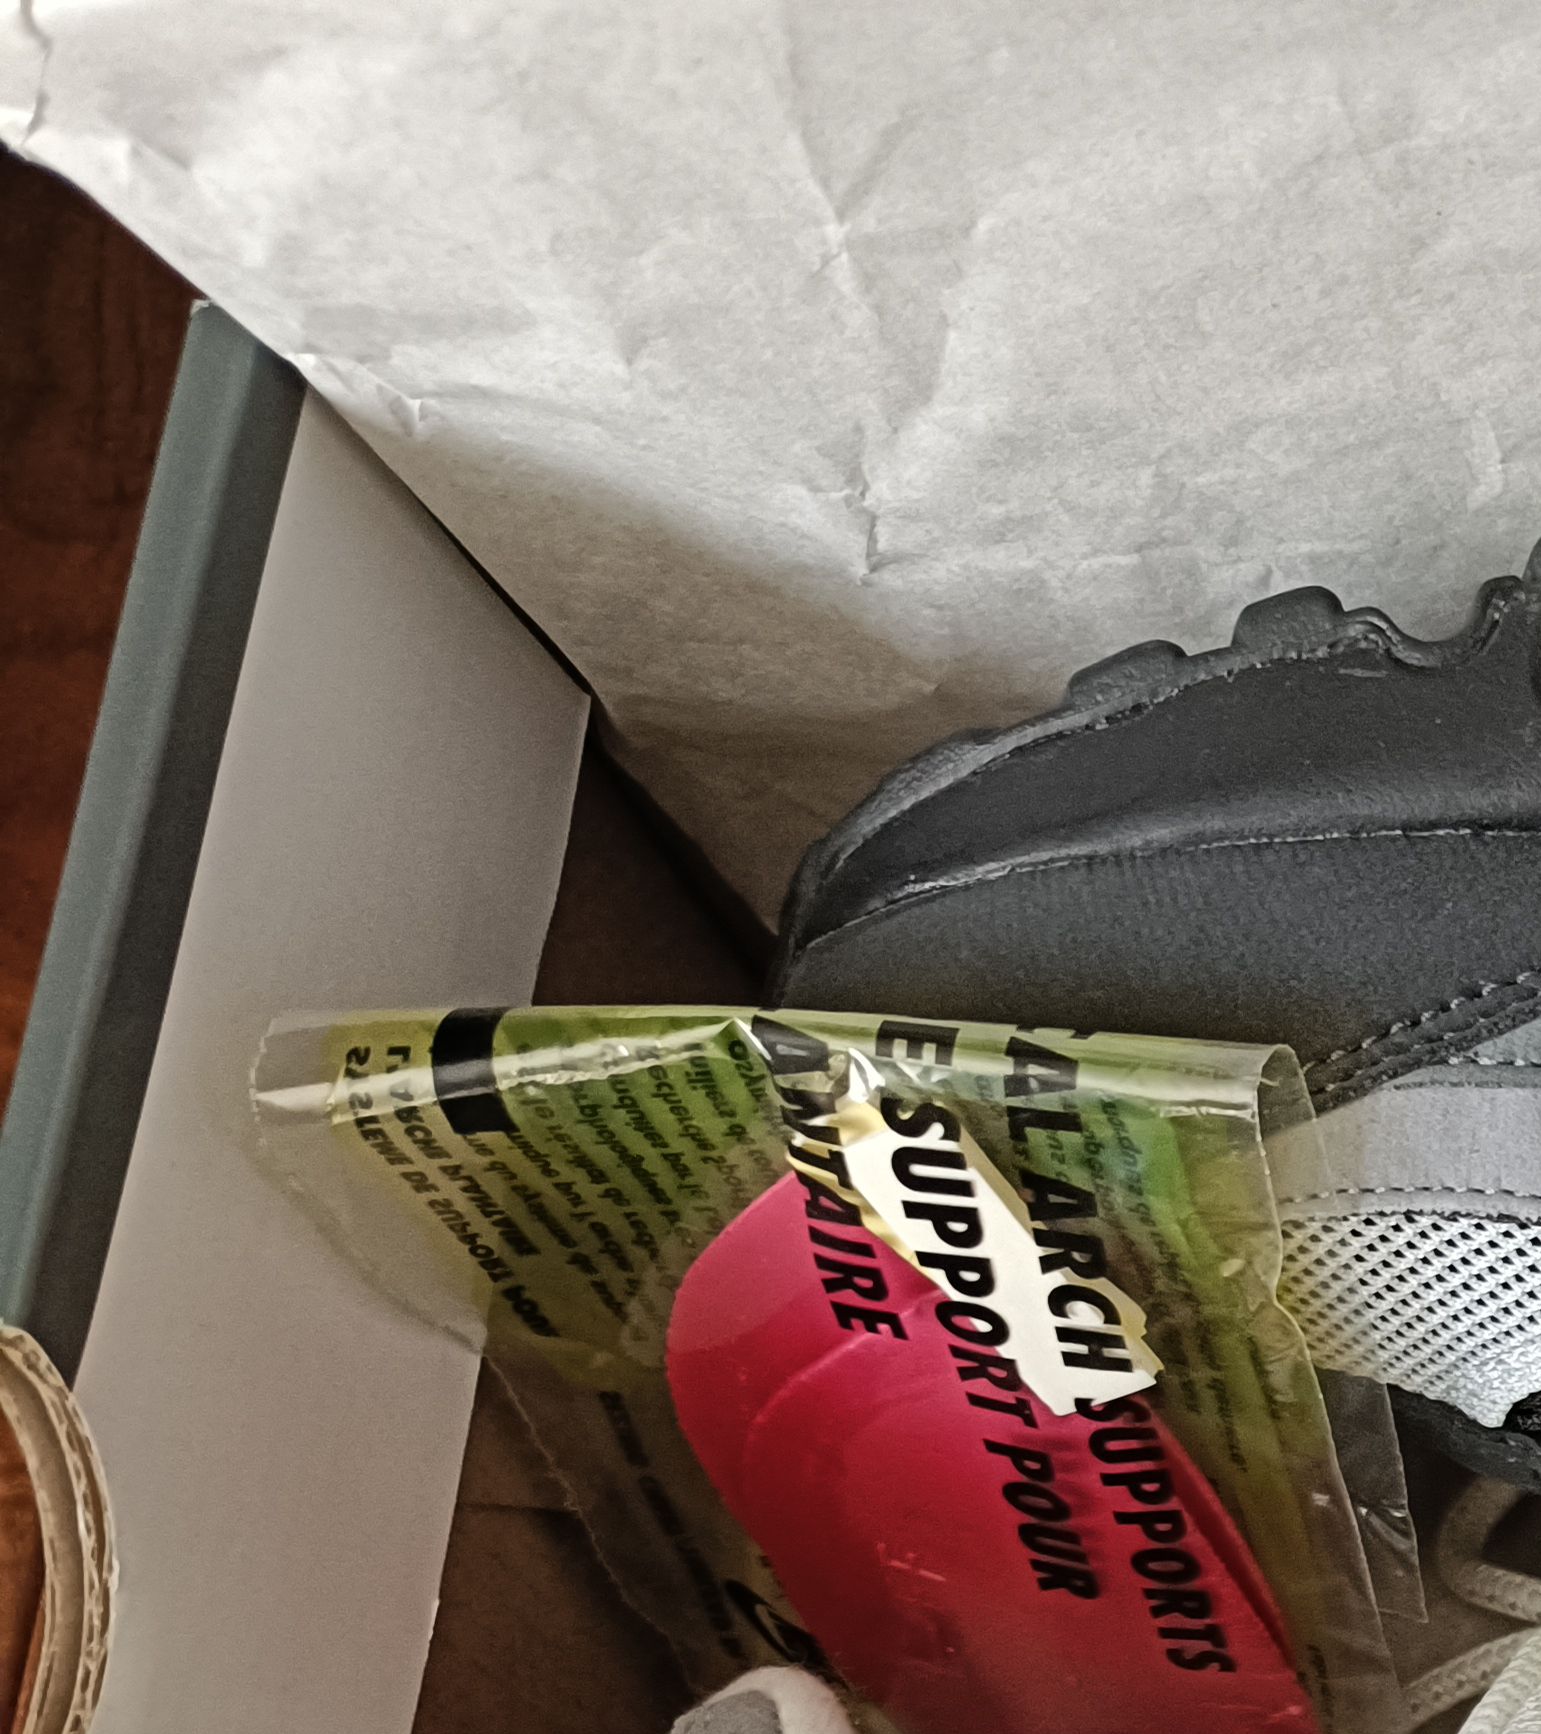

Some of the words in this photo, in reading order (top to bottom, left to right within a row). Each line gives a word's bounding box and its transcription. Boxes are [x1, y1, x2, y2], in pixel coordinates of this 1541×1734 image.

[880, 1085, 1039, 1429] SUPPORT
[983, 1437, 1101, 1600] POUR
[1018, 1168, 1134, 1374] ARCH
[1073, 1396, 1237, 1674] SUPPORTS
